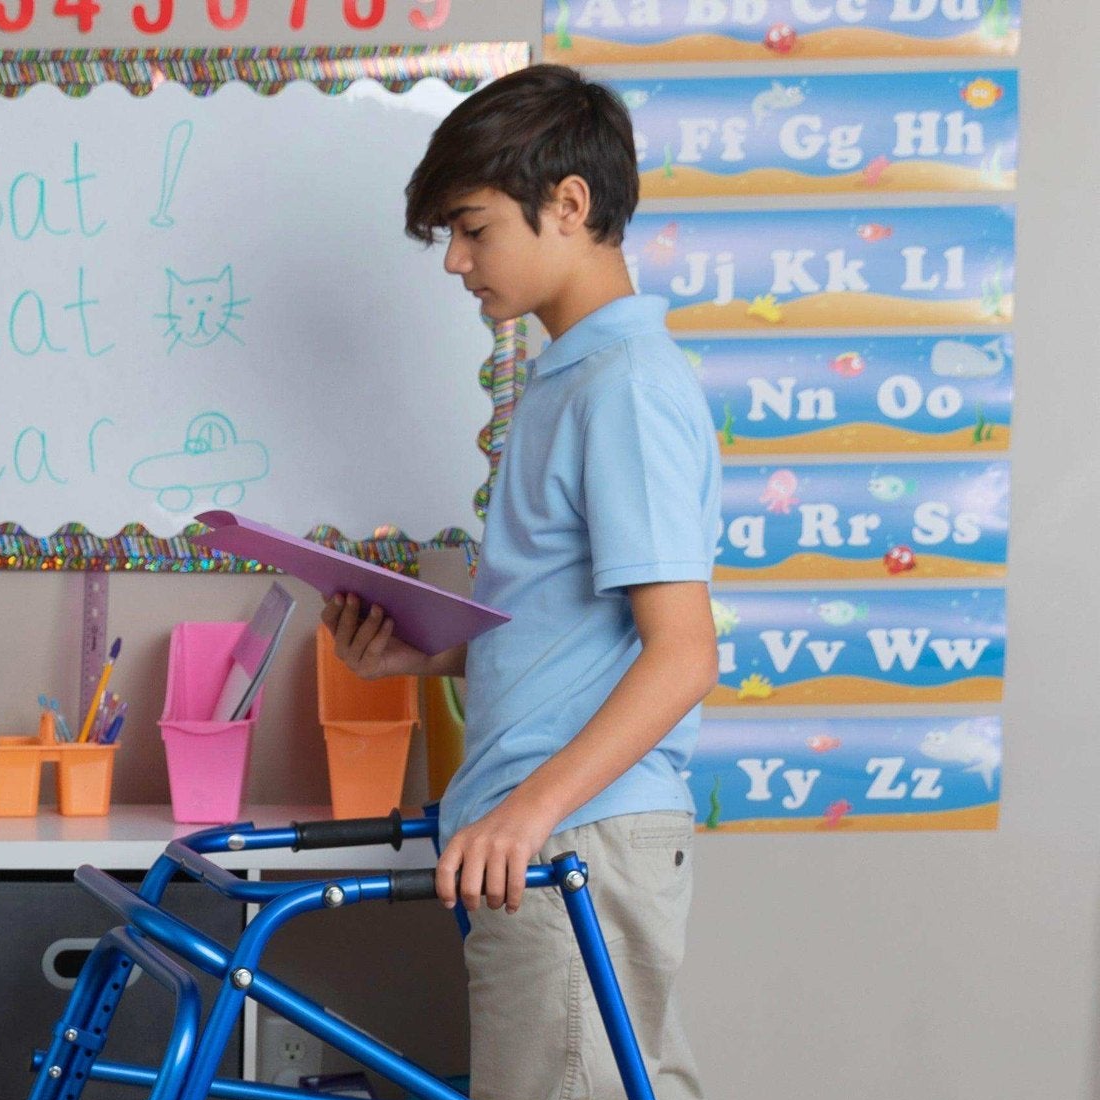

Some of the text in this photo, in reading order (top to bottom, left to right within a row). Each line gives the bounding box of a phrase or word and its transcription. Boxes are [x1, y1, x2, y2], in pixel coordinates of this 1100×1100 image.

[575, 0, 662, 28] Aa
[676, 117, 747, 163] Ff
[777, 114, 863, 169] Gg
[891, 111, 984, 157] Hh
[670, 252, 736, 306] Jj
[770, 249, 869, 295] Kk
[901, 246, 965, 292] Ll
[745, 374, 963, 423] Nn Oo
[714, 501, 982, 558] q Rr Ss
[759, 629, 846, 674] Vv
[866, 627, 991, 671] Ww
[736, 756, 944, 810] Yy Zz
